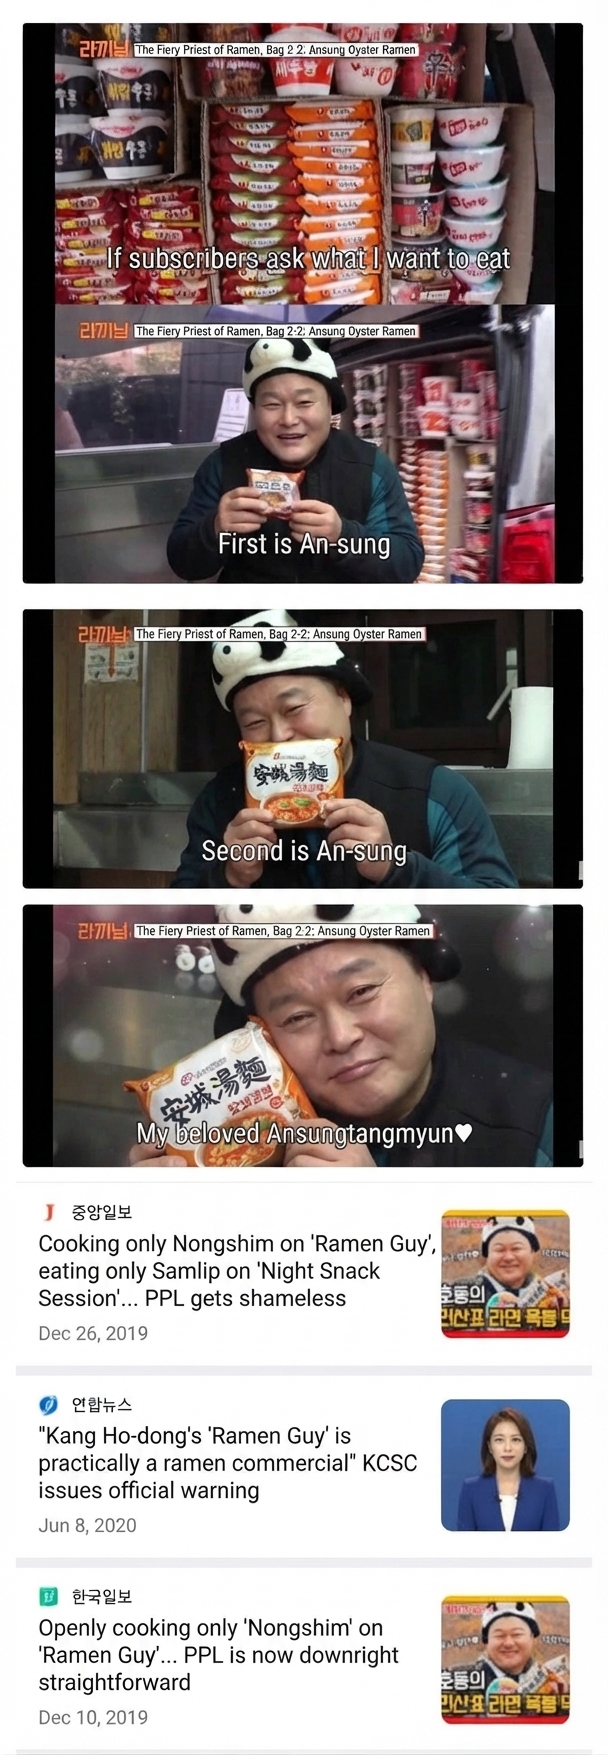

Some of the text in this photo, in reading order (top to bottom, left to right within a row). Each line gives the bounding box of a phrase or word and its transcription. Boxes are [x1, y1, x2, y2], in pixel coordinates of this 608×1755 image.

[72, 1204, 133, 1222] 중앙일보
[38, 1233, 120, 1257] Cooking
[125, 1233, 168, 1257] only
[173, 1233, 274, 1257] Nongshim
[280, 1238, 305, 1253] on
[310, 1233, 384, 1253] 'Ramen
[389, 1233, 436, 1258] Guy',
[38, 1260, 381, 1285] eating only Samlip on 'Night Snack
[38, 1287, 347, 1312] Session'... PPL gets shameless
[39, 1325, 148, 1344] Dec 26, 2019
[72, 1396, 133, 1414] 연합뉴스
[38, 1424, 352, 1450] "Kang Ho-dong's 'Ramen Guy' is
[38, 1452, 418, 1477] practically a ramen commercial" KCSC
[39, 1479, 260, 1504] issues official warning
[38, 1517, 137, 1536] Jun 8, 2020
[72, 1588, 133, 1606] 한국일보
[38, 1617, 383, 1642] Openly cooking only 'Nongshim' on
[38, 1644, 400, 1669] 'Ramen Guy'... PPL is now downright
[38, 1671, 191, 1696] straightforward
[39, 1709, 148, 1728] Dec 10, 2019
